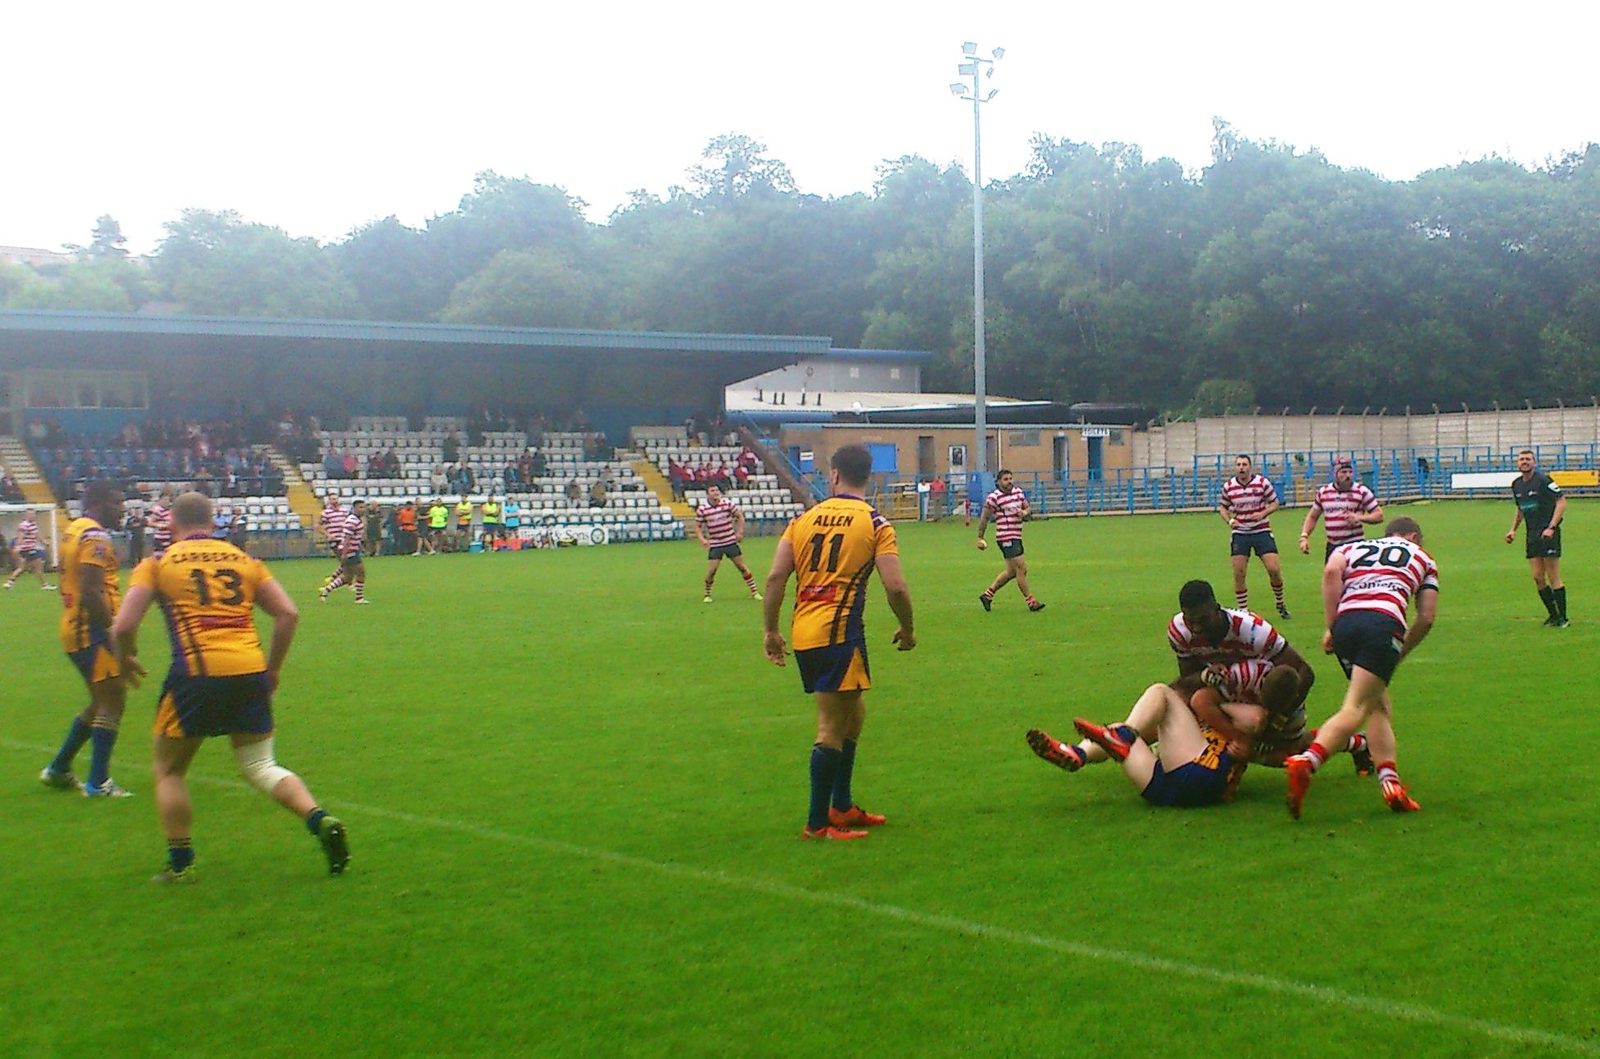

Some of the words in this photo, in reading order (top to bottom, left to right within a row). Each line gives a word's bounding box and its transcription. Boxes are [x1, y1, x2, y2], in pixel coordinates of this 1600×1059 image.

[812, 514, 854, 527] ALLEN
[809, 533, 845, 572] 11
[1350, 544, 1412, 569] 20
[190, 568, 244, 606] 13
